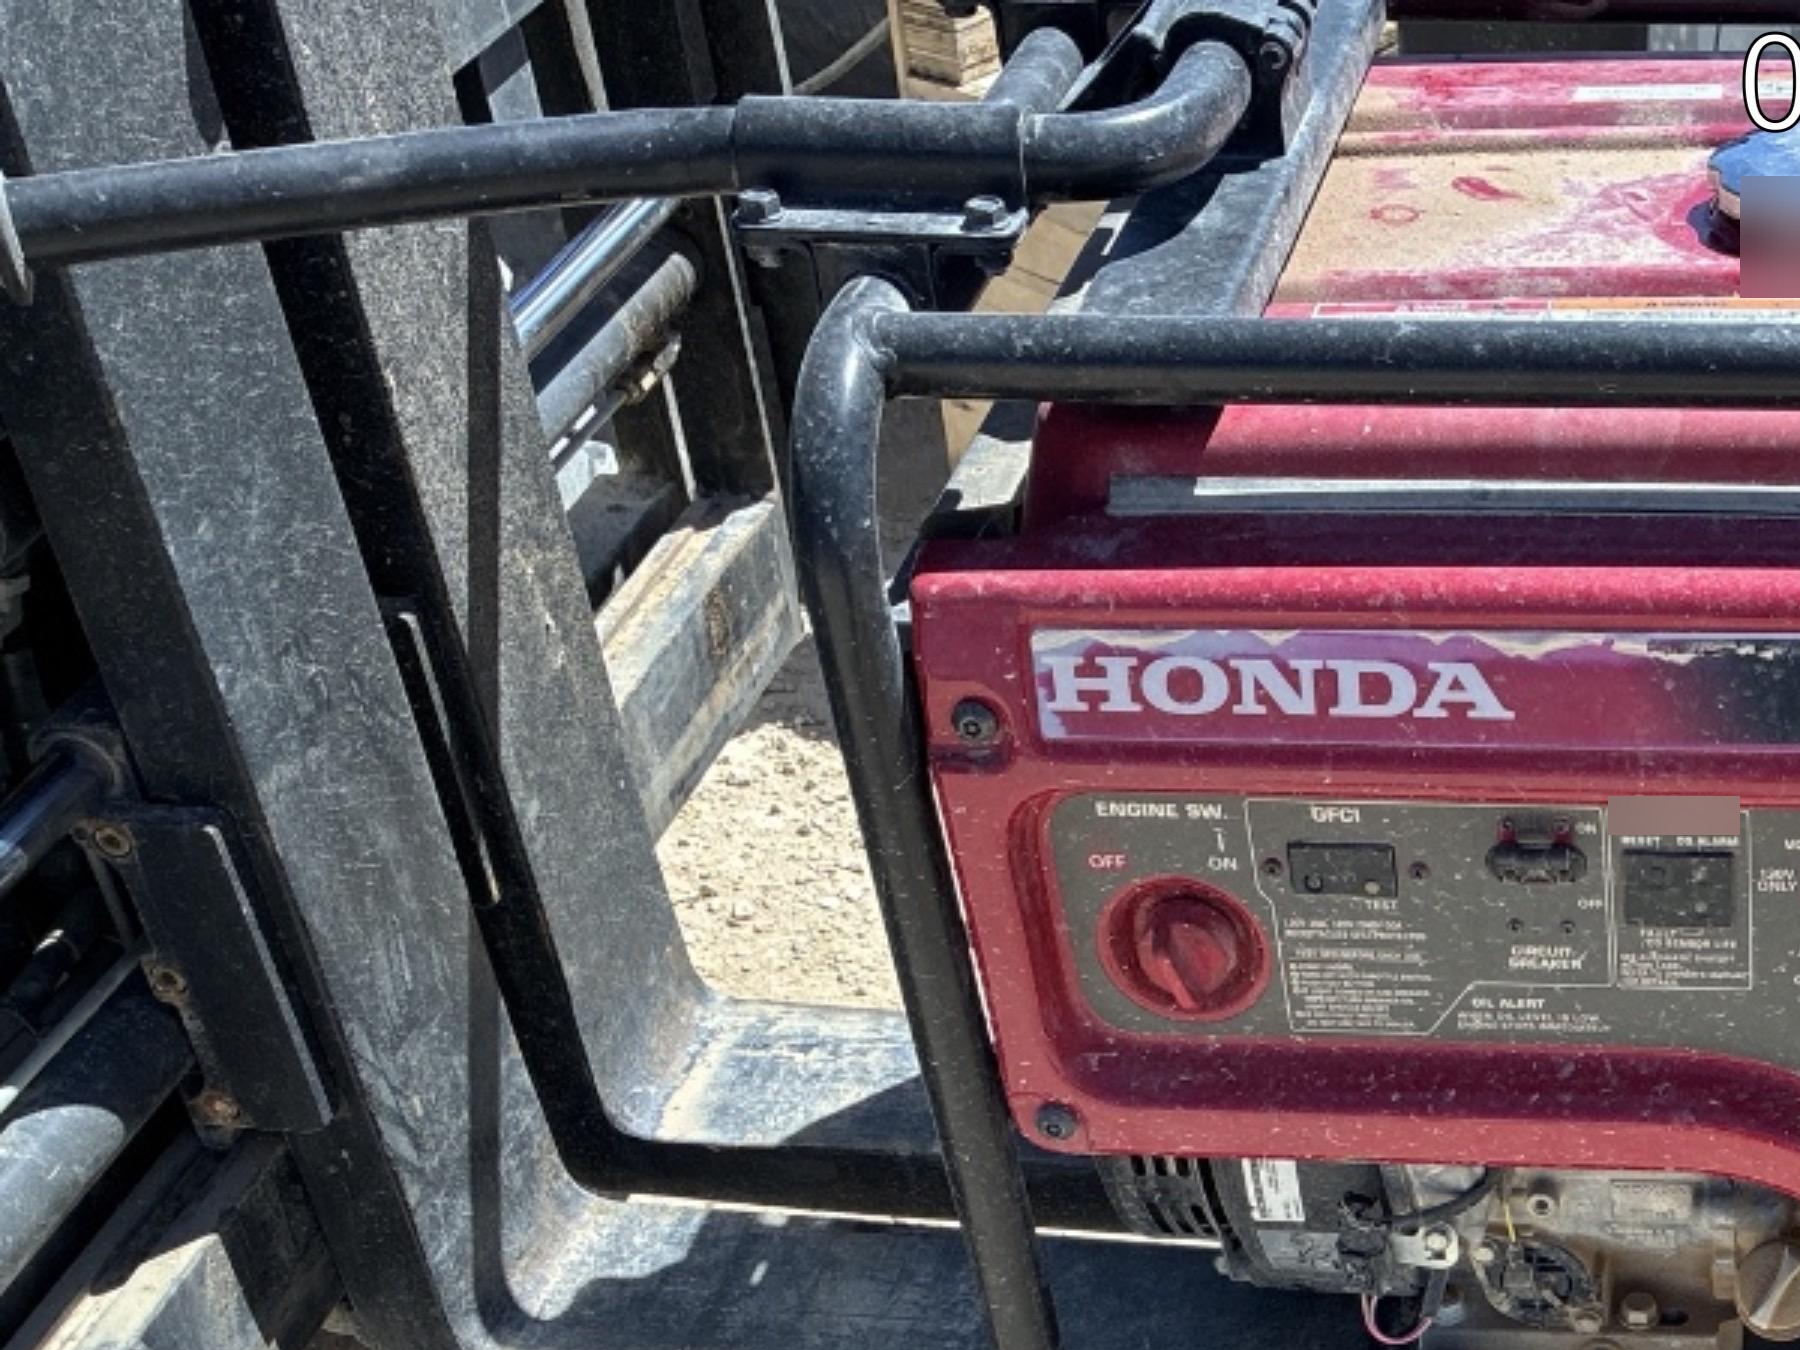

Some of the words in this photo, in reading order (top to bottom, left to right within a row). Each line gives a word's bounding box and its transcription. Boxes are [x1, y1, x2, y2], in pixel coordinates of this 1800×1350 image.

[1042, 654, 1515, 721] HONDA
[1095, 801, 1178, 819] ENGINE
[1310, 805, 1361, 824] GFCI
[1087, 854, 1128, 869] OFF
[1207, 856, 1238, 872] ON
[1757, 881, 1798, 892] ONLY
[1511, 945, 1573, 957] CIRCUIT
[1508, 957, 1582, 970] BREAKER
[1500, 998, 1546, 1009] ALERT
